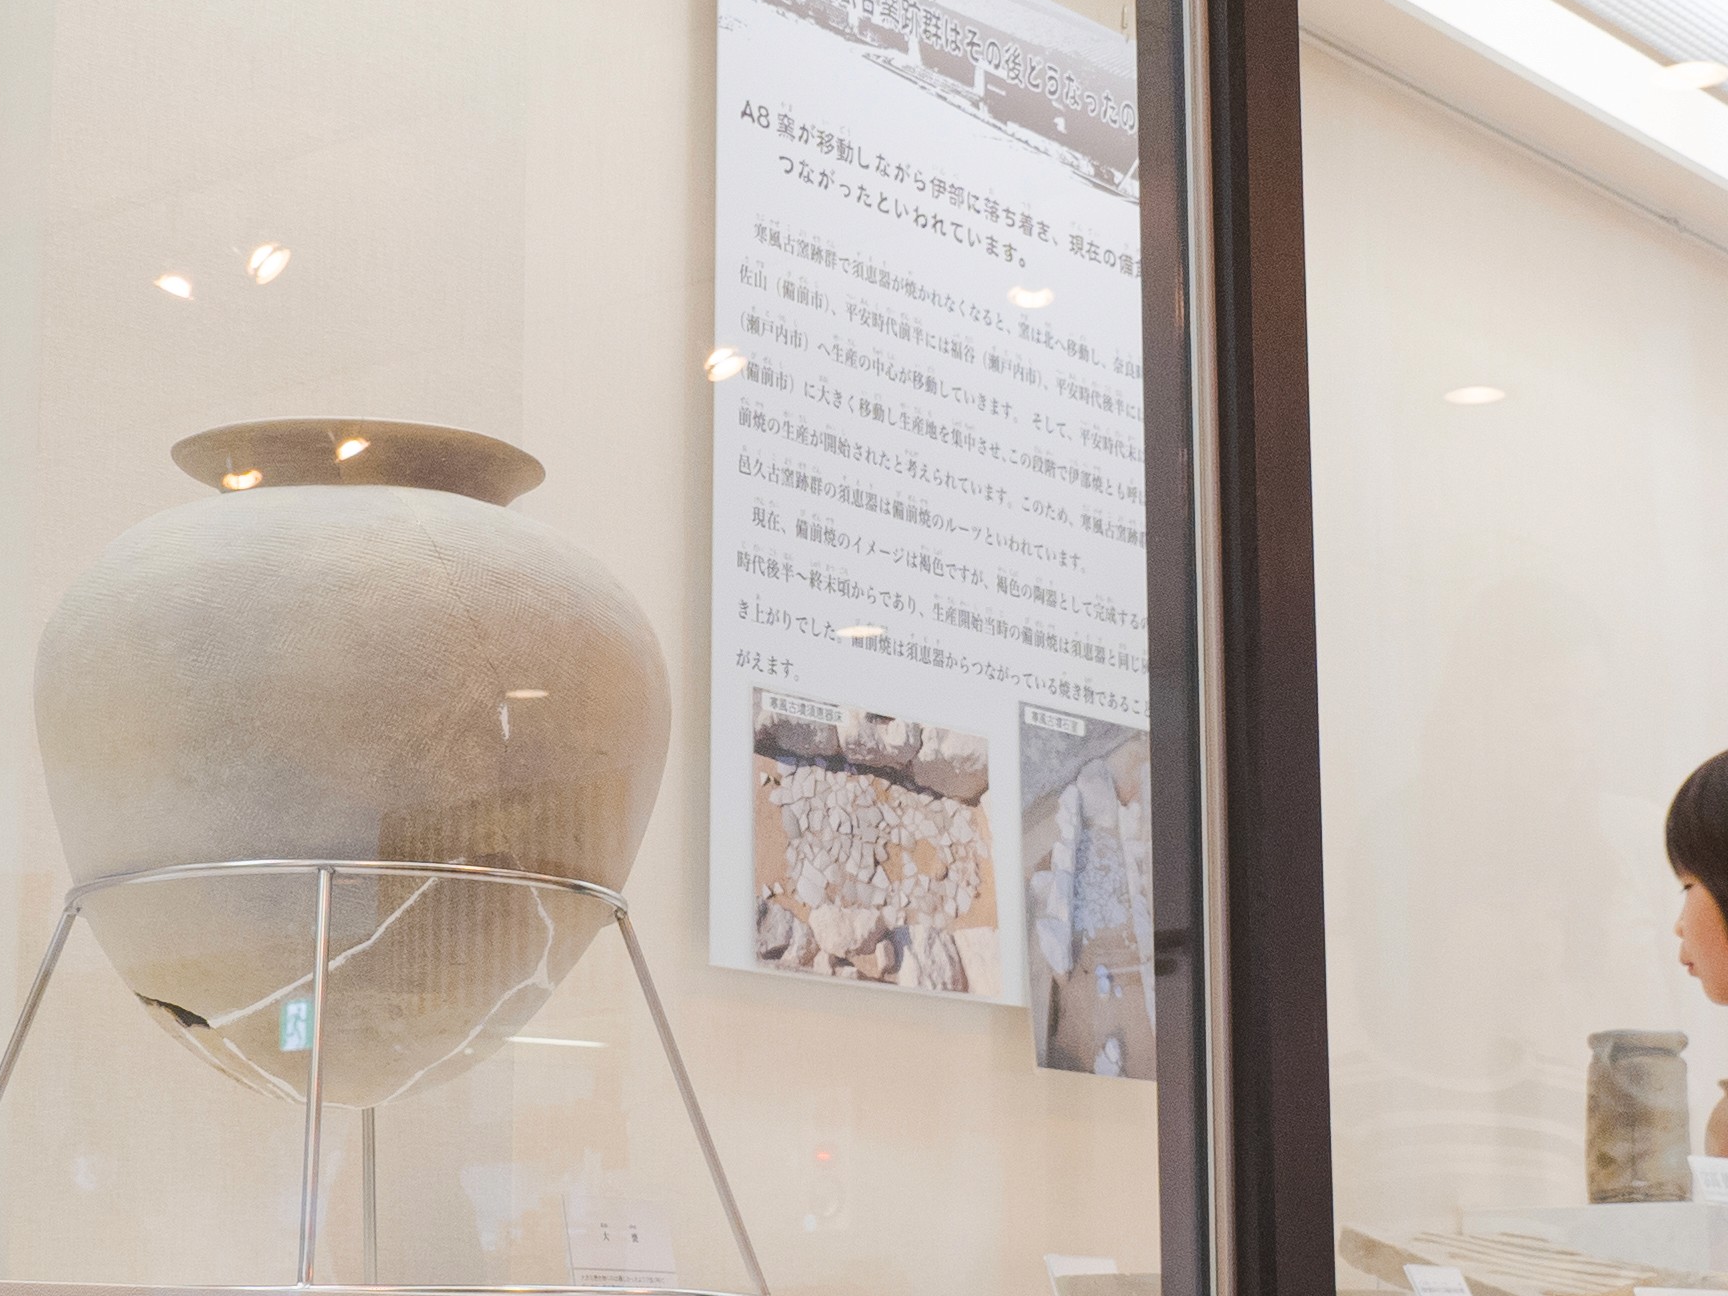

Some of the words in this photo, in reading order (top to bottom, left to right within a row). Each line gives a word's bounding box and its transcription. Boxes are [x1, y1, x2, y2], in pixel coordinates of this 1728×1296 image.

[739, 98, 772, 133] A8
[735, 647, 800, 682] がえます。
